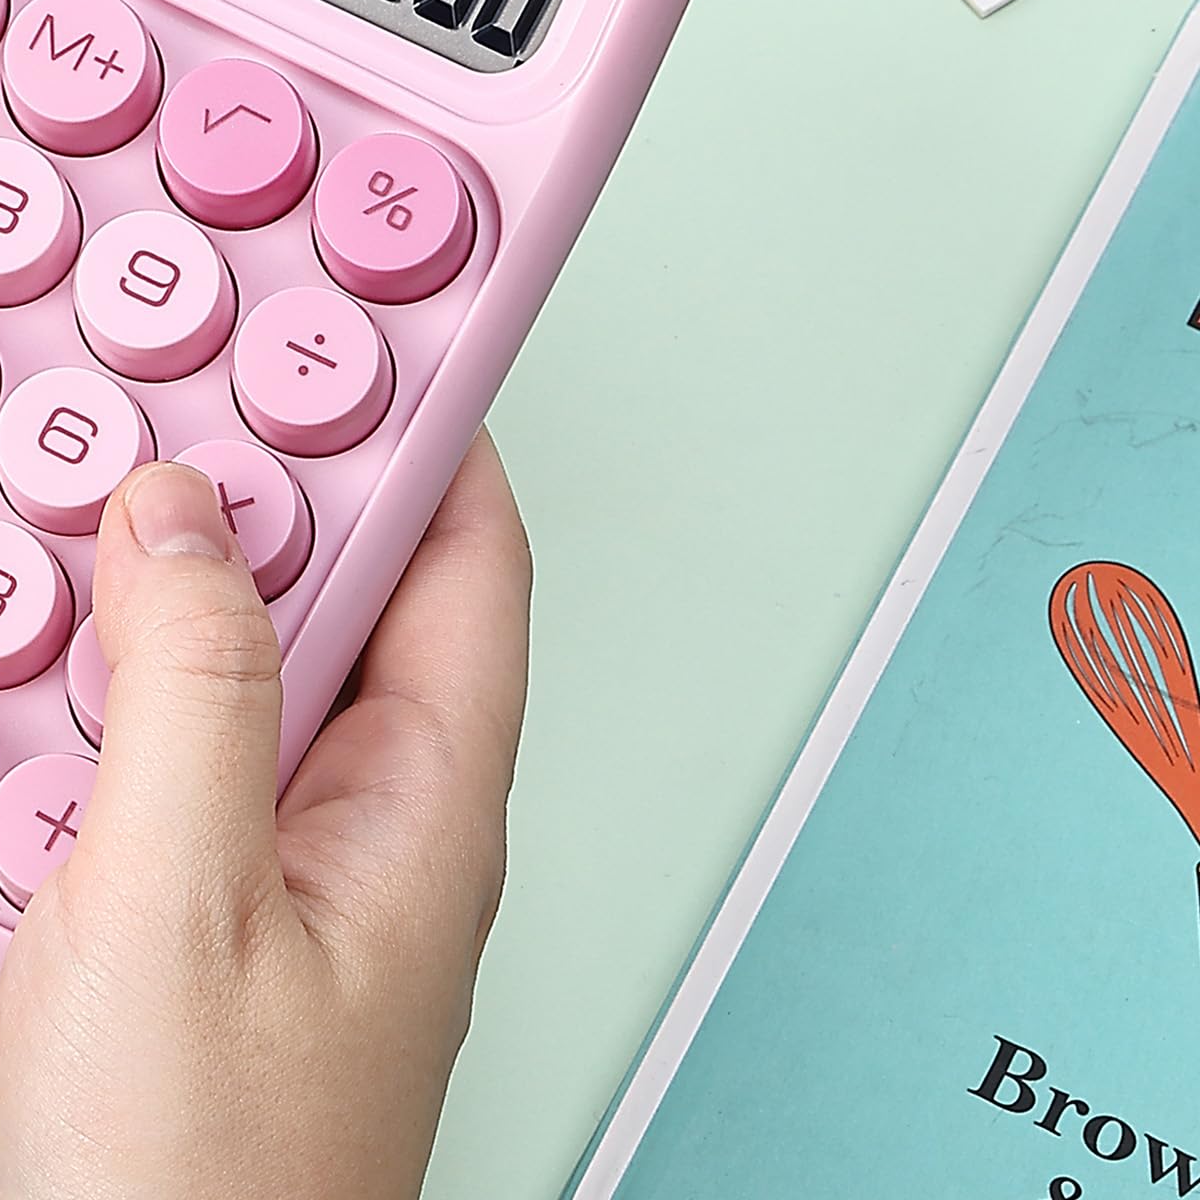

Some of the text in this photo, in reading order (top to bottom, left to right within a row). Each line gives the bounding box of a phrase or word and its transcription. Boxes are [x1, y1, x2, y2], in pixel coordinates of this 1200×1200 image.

[29, 13, 126, 81] M+
[119, 249, 181, 307] 9
[37, 406, 99, 465] 6
